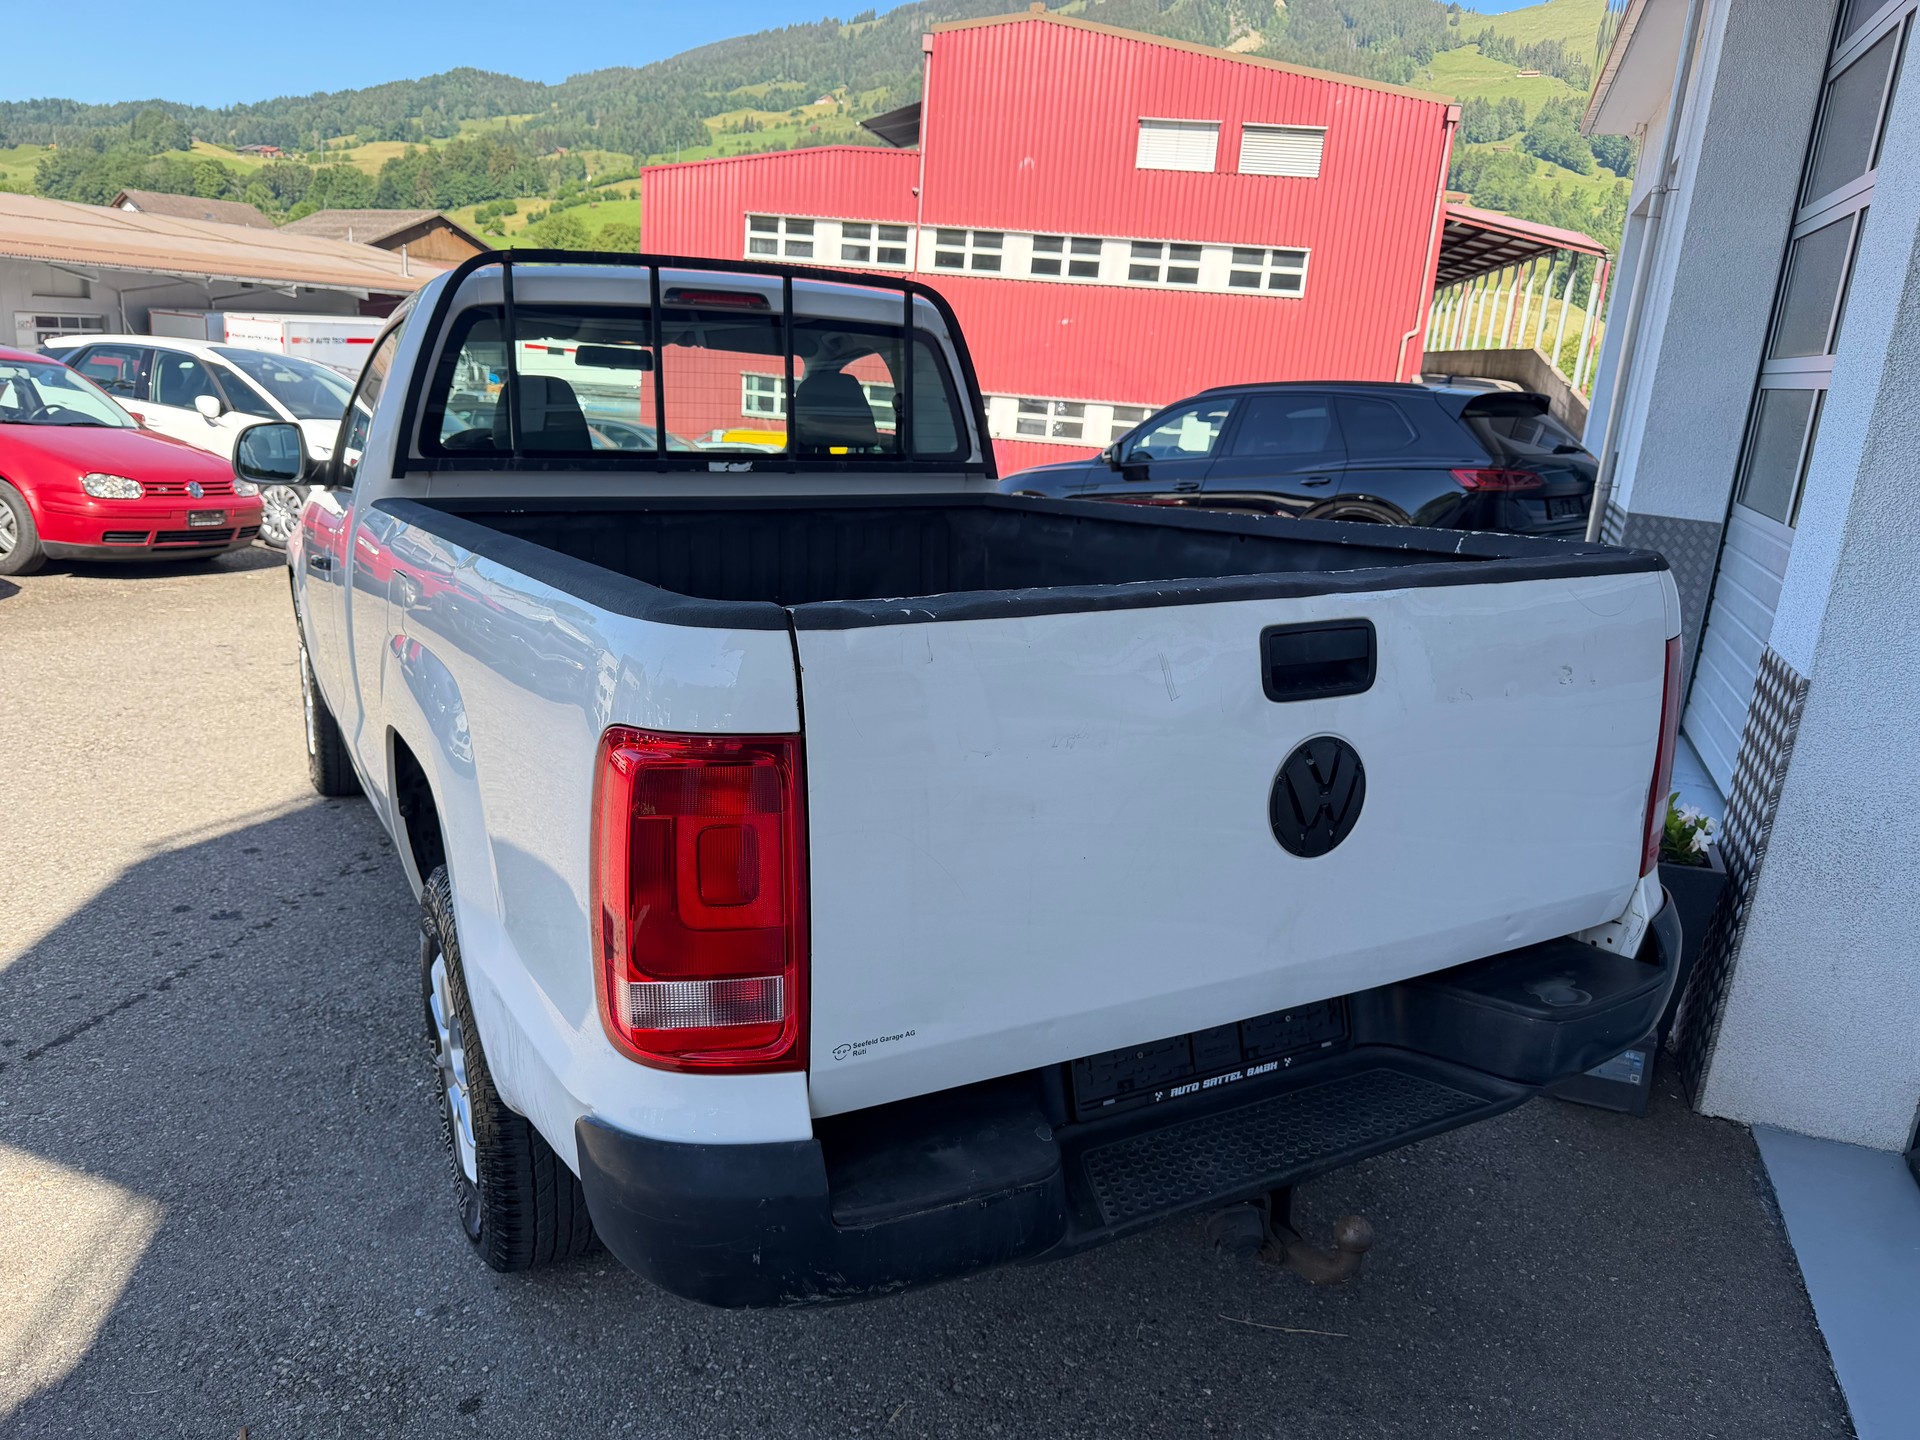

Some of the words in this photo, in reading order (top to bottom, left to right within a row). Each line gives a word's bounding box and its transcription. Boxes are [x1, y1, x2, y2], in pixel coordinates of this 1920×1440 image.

[1271, 736, 1365, 857] VW
[852, 1038, 878, 1049] Seefeld
[879, 1033, 904, 1043] Garage
[905, 1029, 916, 1038] AG
[1170, 1082, 1199, 1098] AUTO
[1202, 1071, 1243, 1089] SATTEL
[1246, 1061, 1278, 1077] GMBH
[429, 1039, 468, 1218] YOKOHAMA
